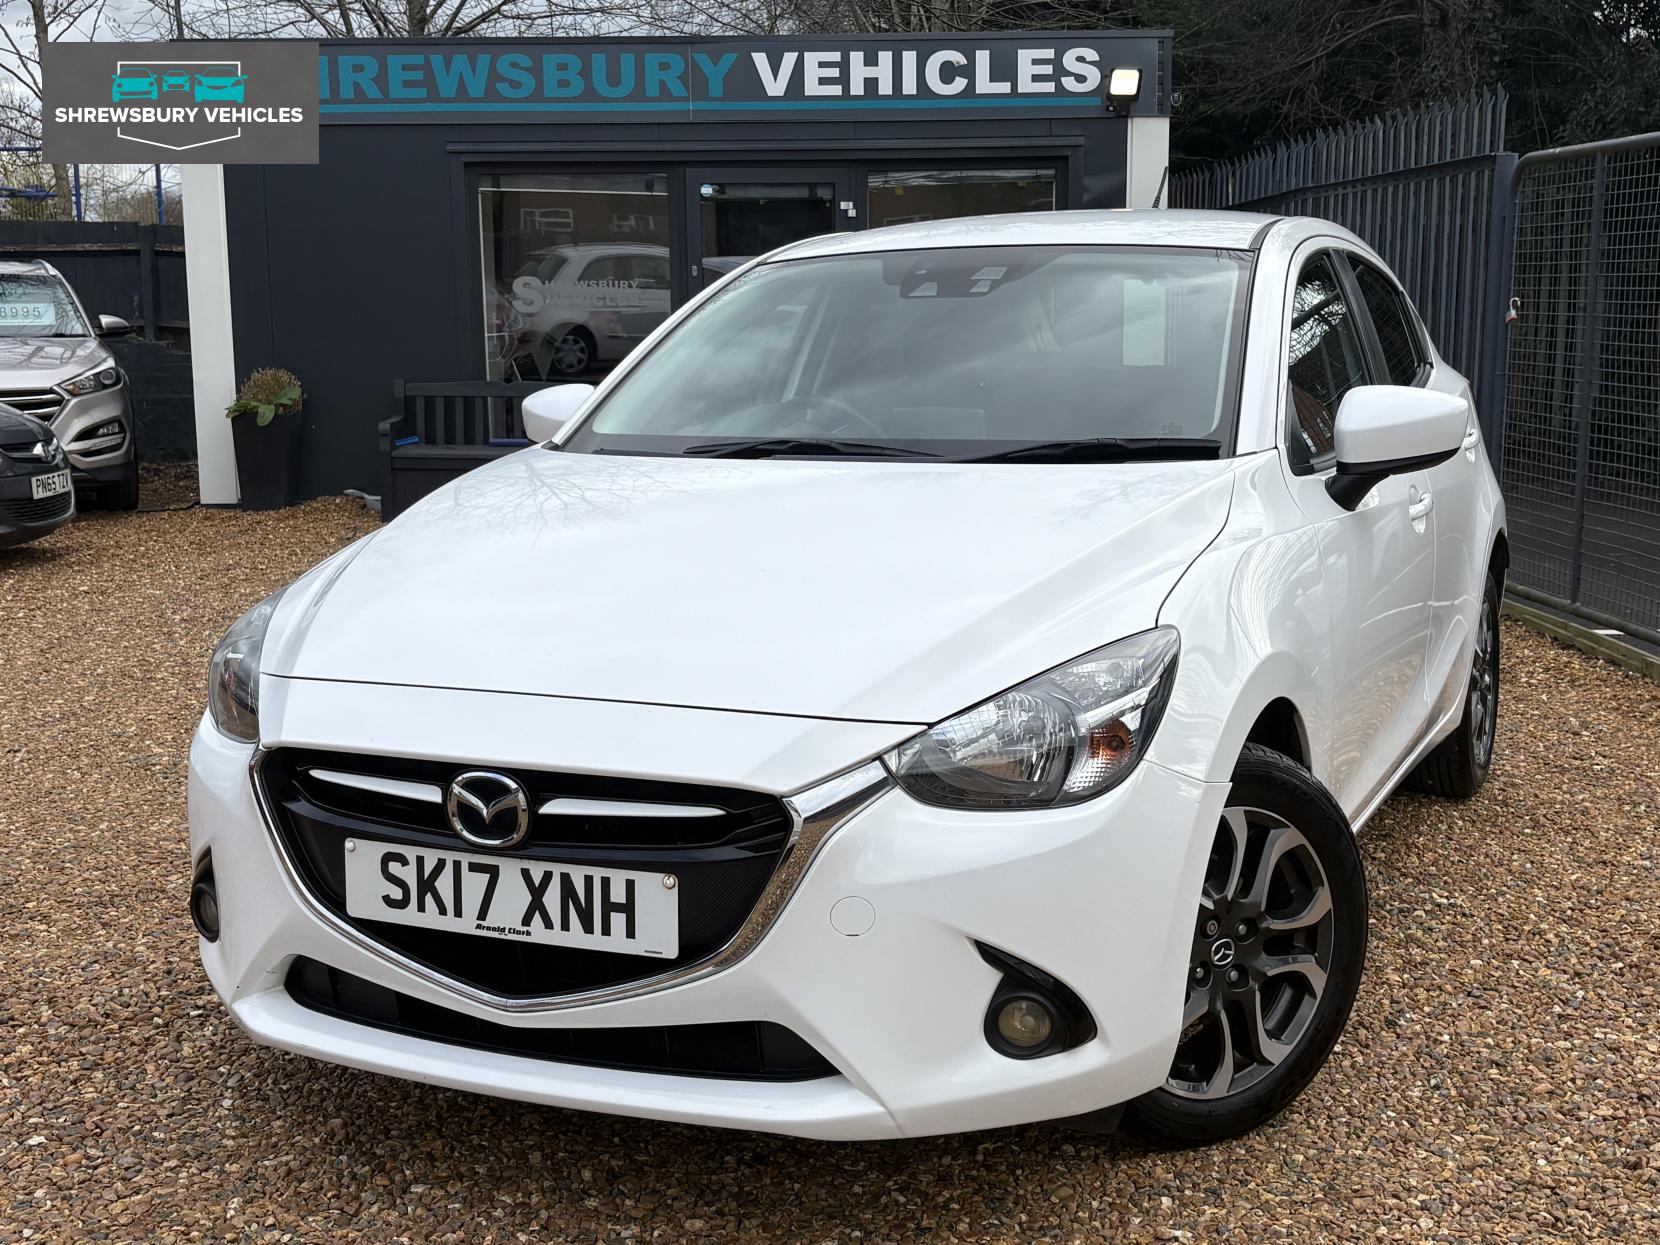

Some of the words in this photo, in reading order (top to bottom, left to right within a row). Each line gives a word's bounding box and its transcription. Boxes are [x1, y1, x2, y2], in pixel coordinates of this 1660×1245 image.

[319, 53, 739, 99] REWSBURY
[751, 47, 1102, 97] VEHICLES
[35, 475, 57, 495] PN65
[380, 851, 500, 922] SK17
[520, 867, 636, 940] XNH
[475, 923, 506, 933] Arnold
[508, 927, 532, 936] Clark
